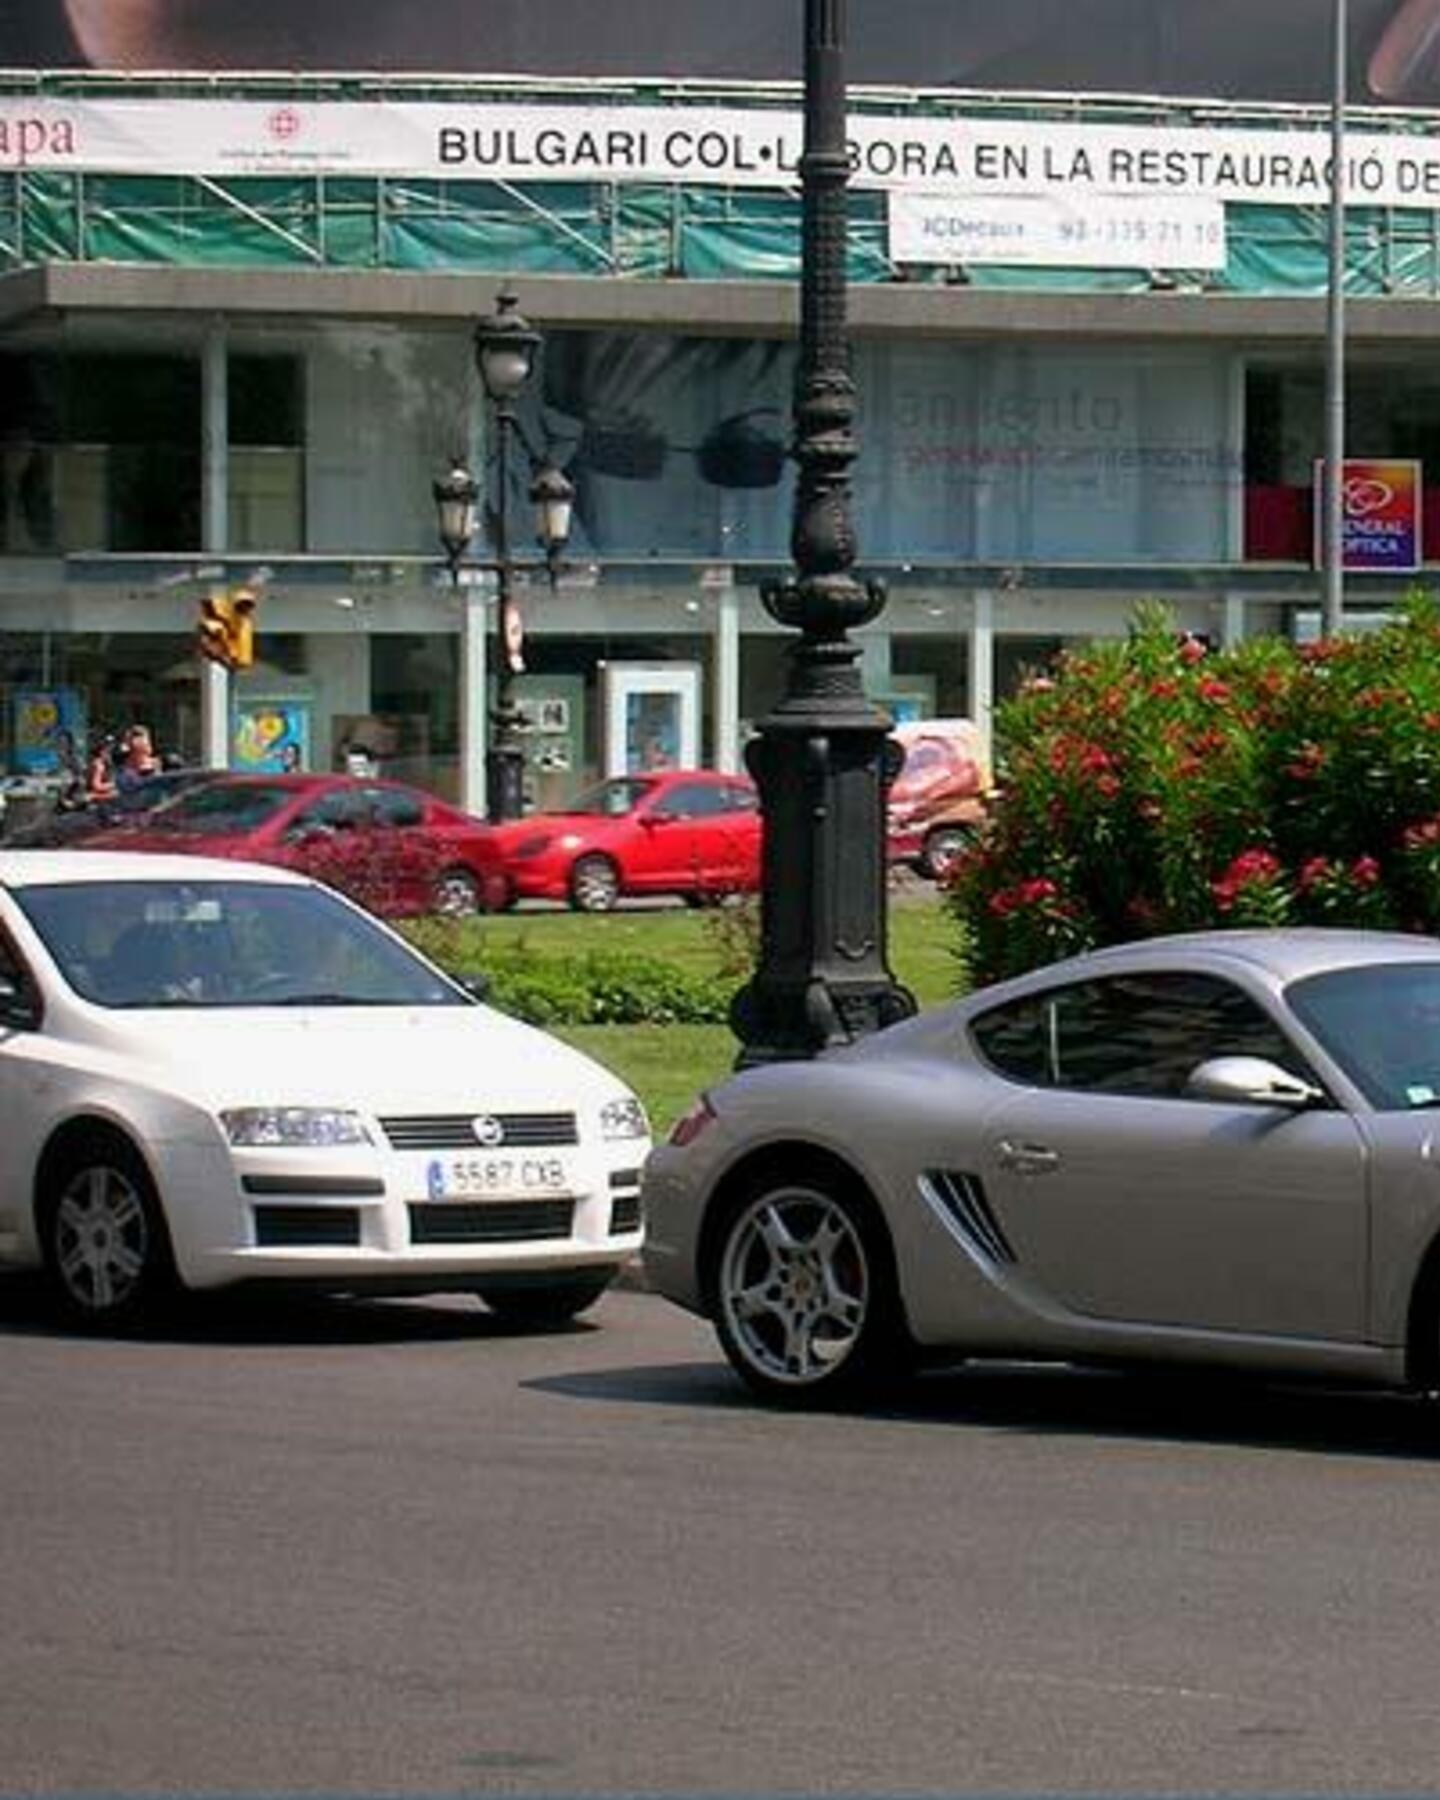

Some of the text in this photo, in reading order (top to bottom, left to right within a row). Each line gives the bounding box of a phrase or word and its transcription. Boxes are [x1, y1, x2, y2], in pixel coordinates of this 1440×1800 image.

[438, 127, 647, 167] BULGARI
[974, 145, 1028, 179] EN
[1044, 148, 1094, 184] LA
[1341, 520, 1408, 536] ENERAL
